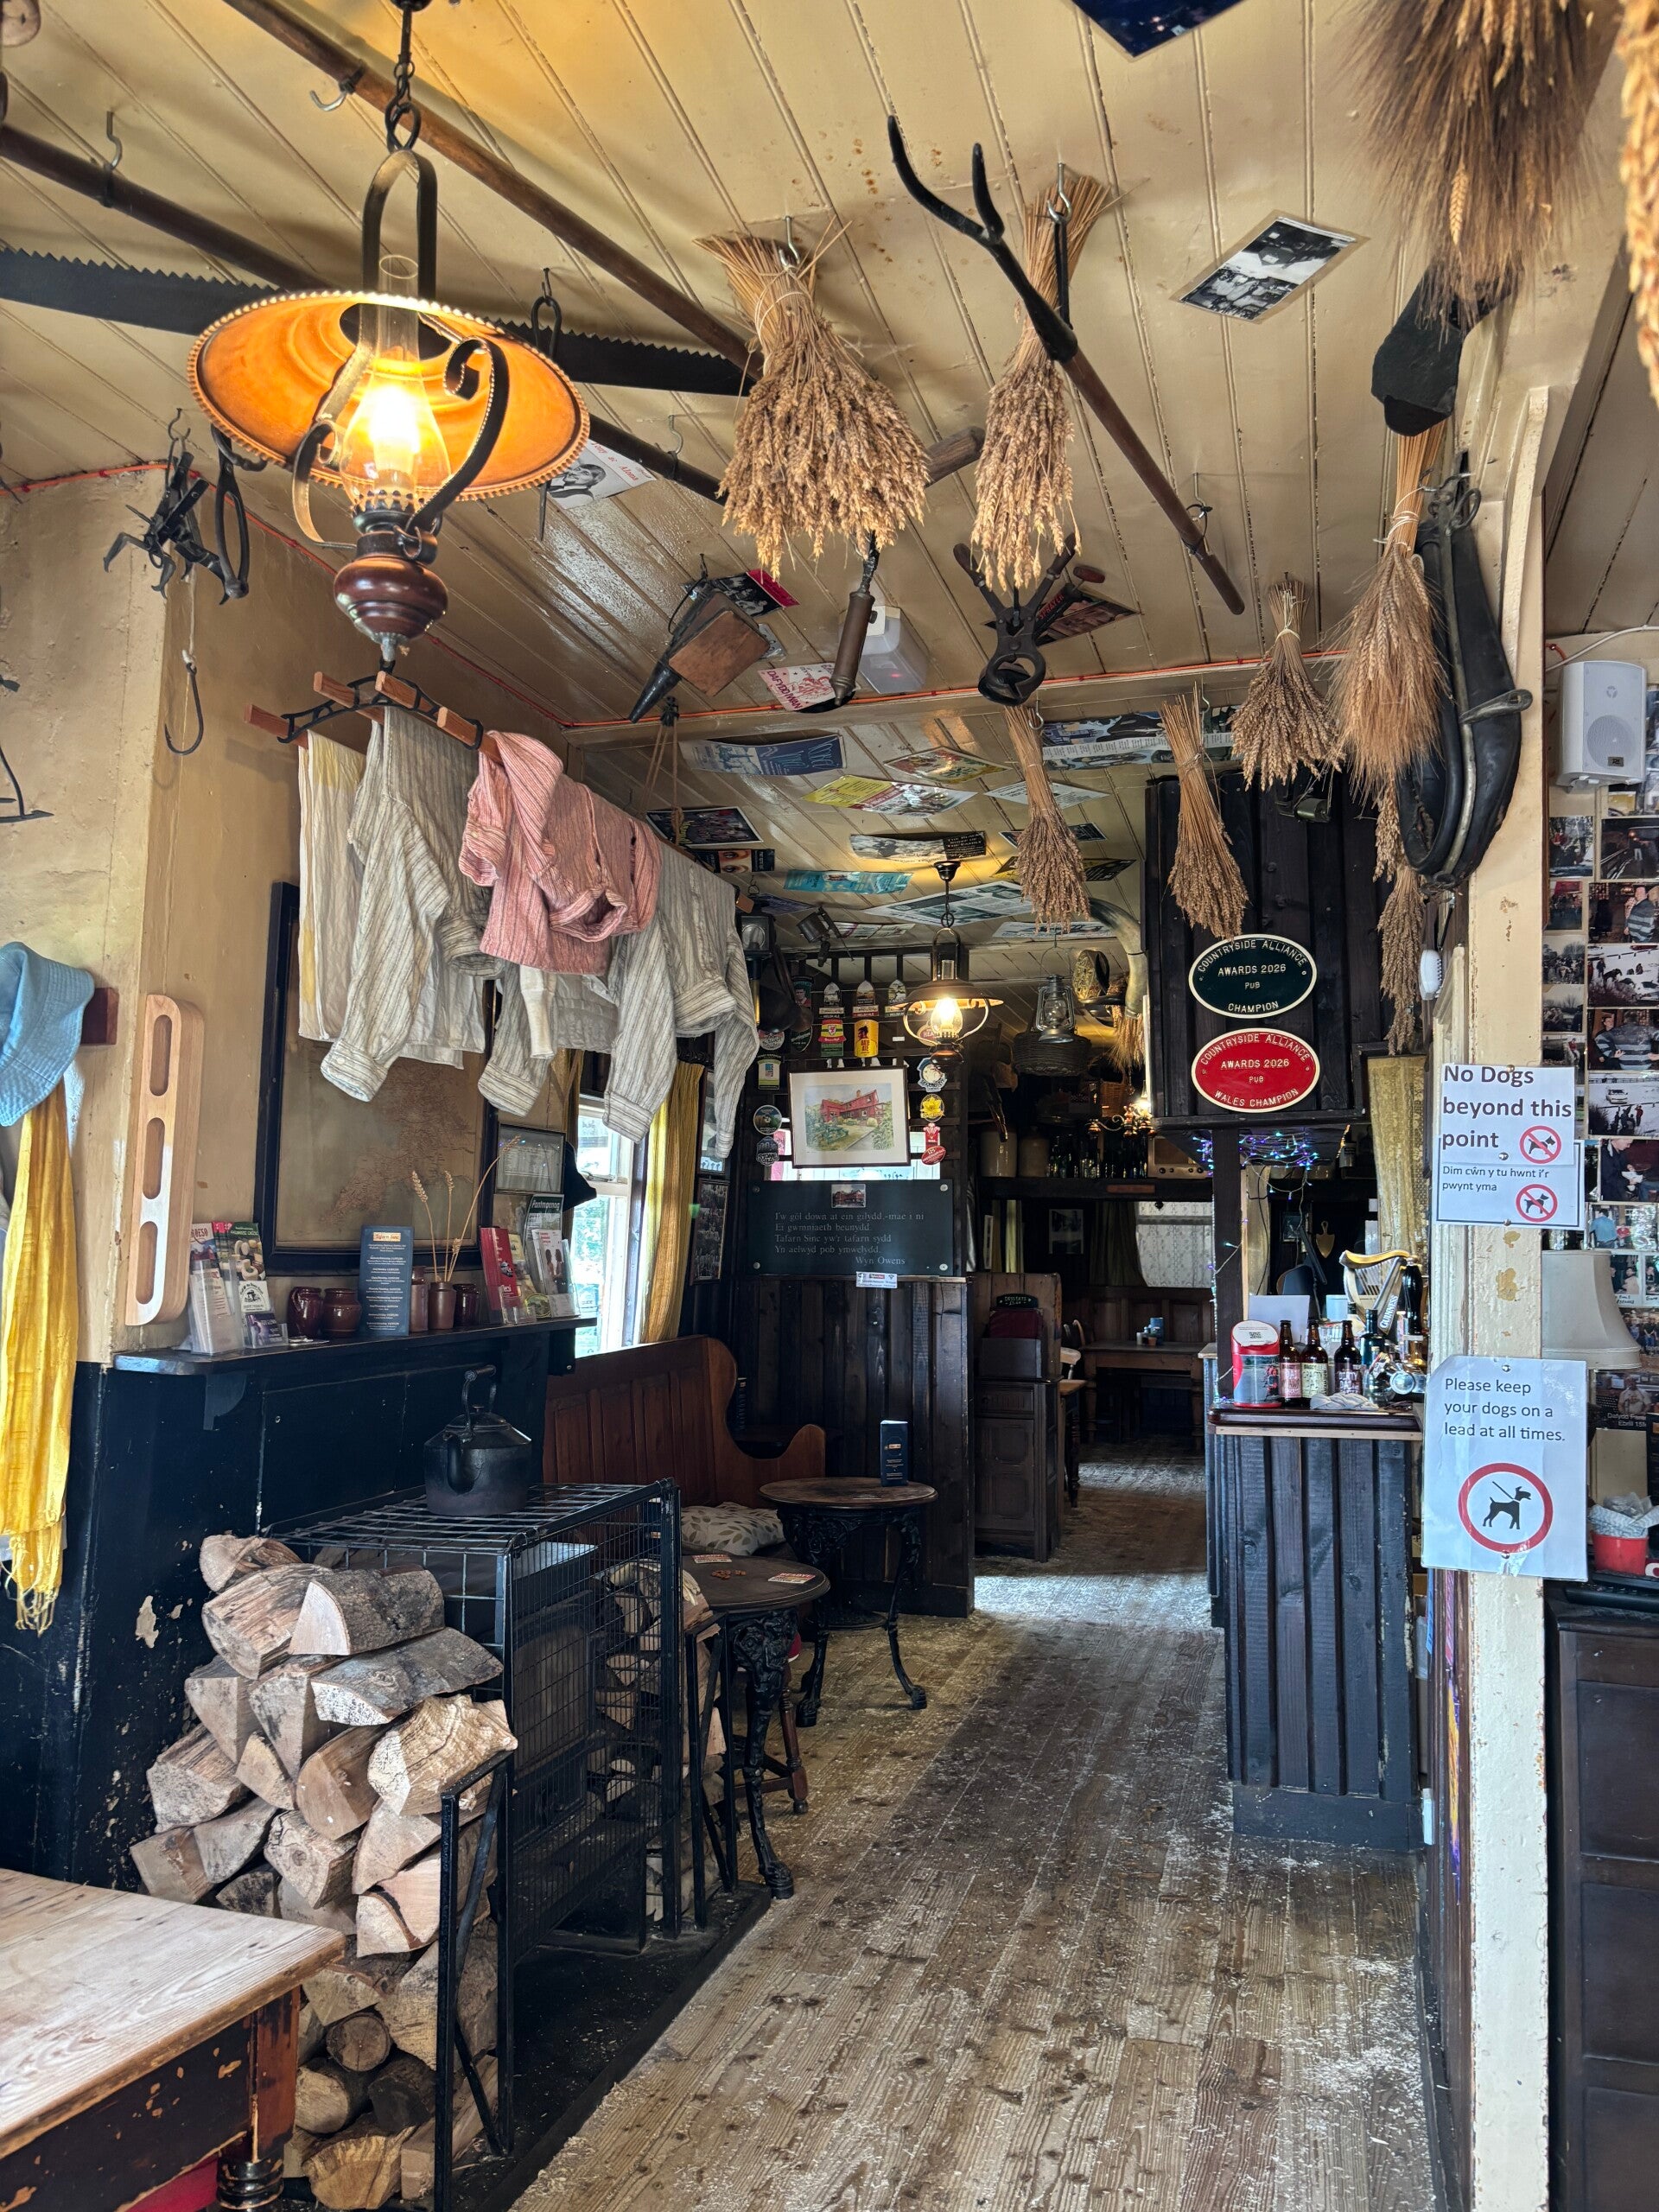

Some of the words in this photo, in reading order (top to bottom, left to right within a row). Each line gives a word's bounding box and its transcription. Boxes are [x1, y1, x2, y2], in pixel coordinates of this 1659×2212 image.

[1039, 594, 1065, 620] SPRAYER
[767, 671, 790, 695] DAFYDD
[785, 692, 804, 709] IWAN
[1198, 939, 1256, 973] COUNTRYSIDE
[1263, 940, 1308, 968] ALLIANCE
[1217, 966, 1258, 976] AWARDS
[1261, 964, 1287, 973] 2026
[1244, 982, 1260, 990] PUB
[1228, 1001, 1279, 1013] CHAMPION
[1201, 1033, 1260, 1065] COUNTRYSIDE
[1265, 1033, 1312, 1063] ALLIANCE
[1220, 1059, 1260, 1070] AWARDS
[1263, 1058, 1290, 1068] 2026
[1444, 1065, 1474, 1083] No
[1481, 1066, 1535, 1088] Dogs
[1214, 1090, 1244, 1107] WALES
[1249, 1089, 1300, 1108] CHAMPION
[1443, 1096, 1523, 1119] beyond
[1531, 1099, 1573, 1118] this
[1441, 1130, 1499, 1150] point
[1443, 1166, 1462, 1177] Dim
[1465, 1166, 1486, 1177] cŵn
[1489, 1169, 1495, 1179] y
[1497, 1168, 1507, 1177] tu
[1510, 1168, 1535, 1179] hwnt
[1442, 1183, 1474, 1193] pwynt
[1475, 1184, 1497, 1194] yma
[774, 1234, 802, 1243] Tafarn
[804, 1234, 821, 1243] Sinc
[844, 1234, 869, 1243] tafarn
[873, 1234, 892, 1244] sydd
[819, 1246, 835, 1255] pob
[855, 1256, 874, 1267] Wyn
[877, 1256, 906, 1265] Owens
[1380, 1294, 1399, 1329] GUINNESS
[1445, 1377, 1491, 1391] Please
[1496, 1379, 1531, 1395] keep
[1445, 1402, 1477, 1415] your
[1482, 1402, 1517, 1418] dogs
[1521, 1407, 1541, 1417] on
[1545, 1408, 1554, 1417] a
[1445, 1422, 1476, 1436] lead
[1479, 1426, 1495, 1438] at
[1498, 1425, 1516, 1439] all
[1520, 1427, 1566, 1441] times.
